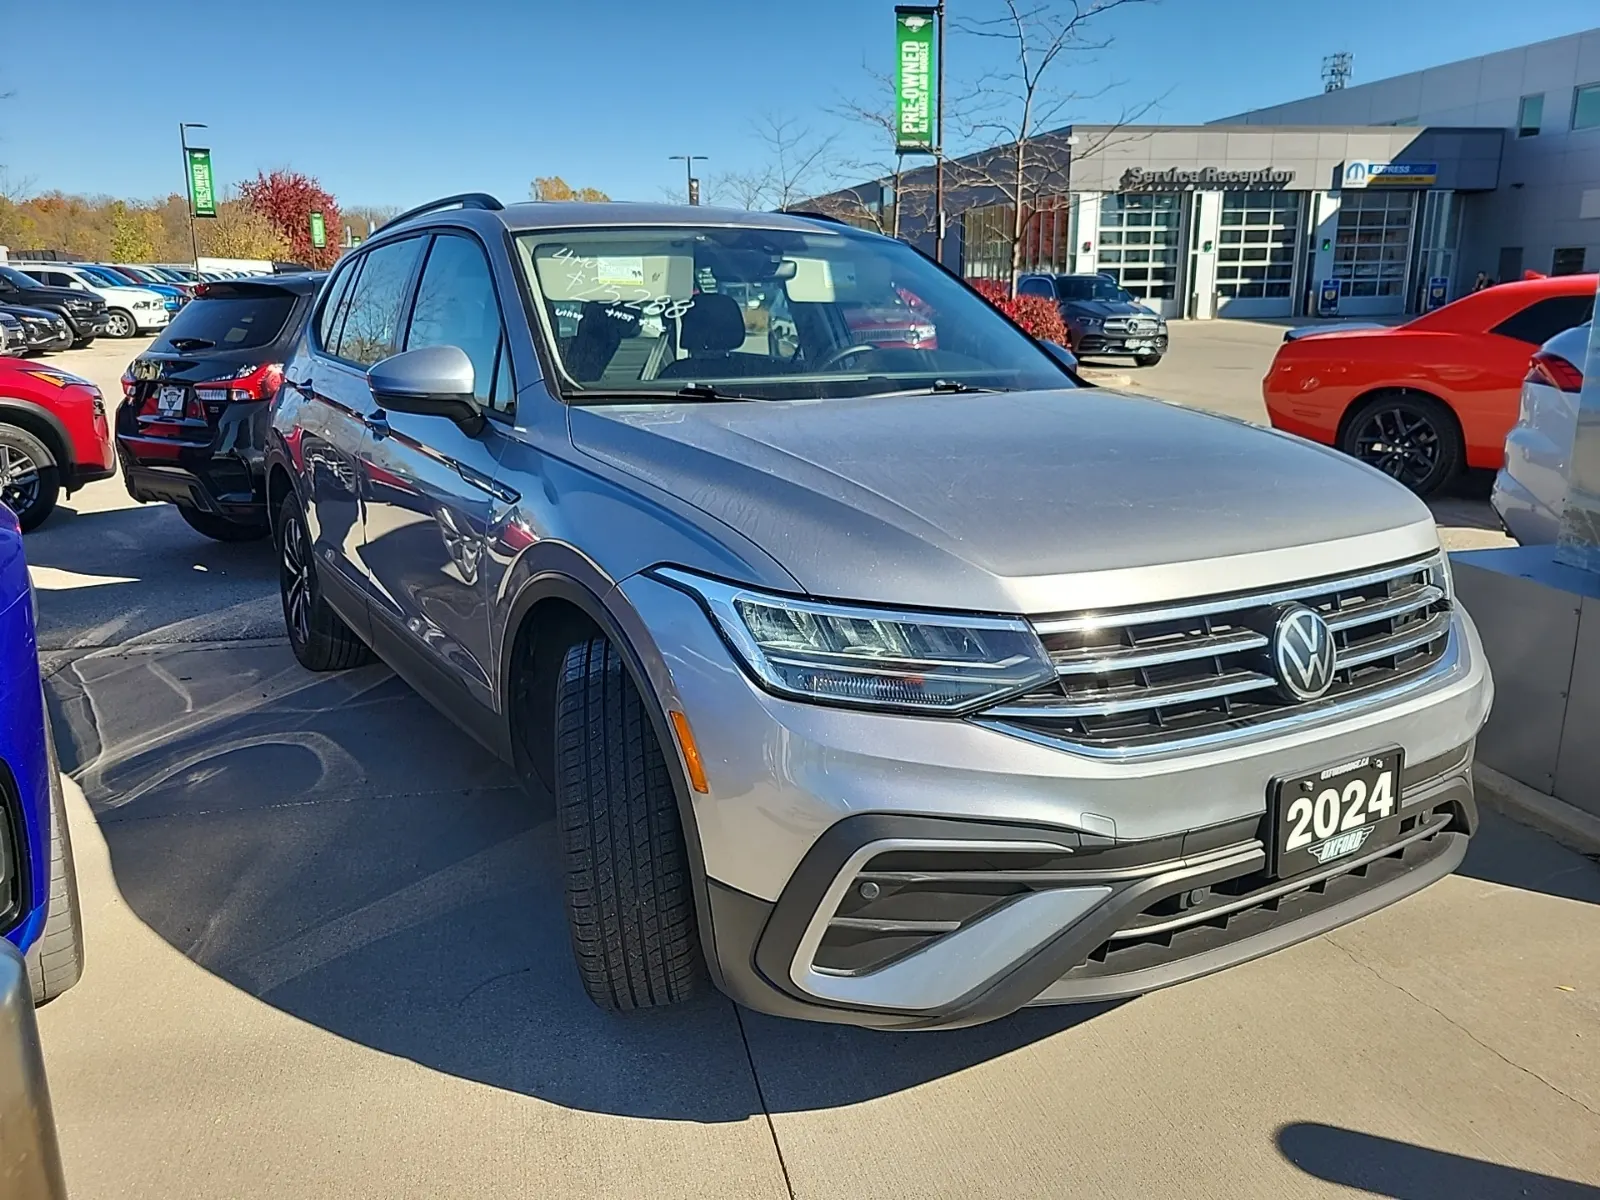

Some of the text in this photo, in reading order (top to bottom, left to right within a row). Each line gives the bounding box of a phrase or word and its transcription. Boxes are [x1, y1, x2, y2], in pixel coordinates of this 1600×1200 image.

[901, 40, 920, 134] PRE-OWNED
[193, 164, 208, 208] PRE-OWNED
[1130, 166, 1297, 185] Service Reception
[1371, 165, 1410, 174] EXPRESS
[1286, 770, 1394, 852] 2024
[1320, 830, 1364, 861] OXFORD
